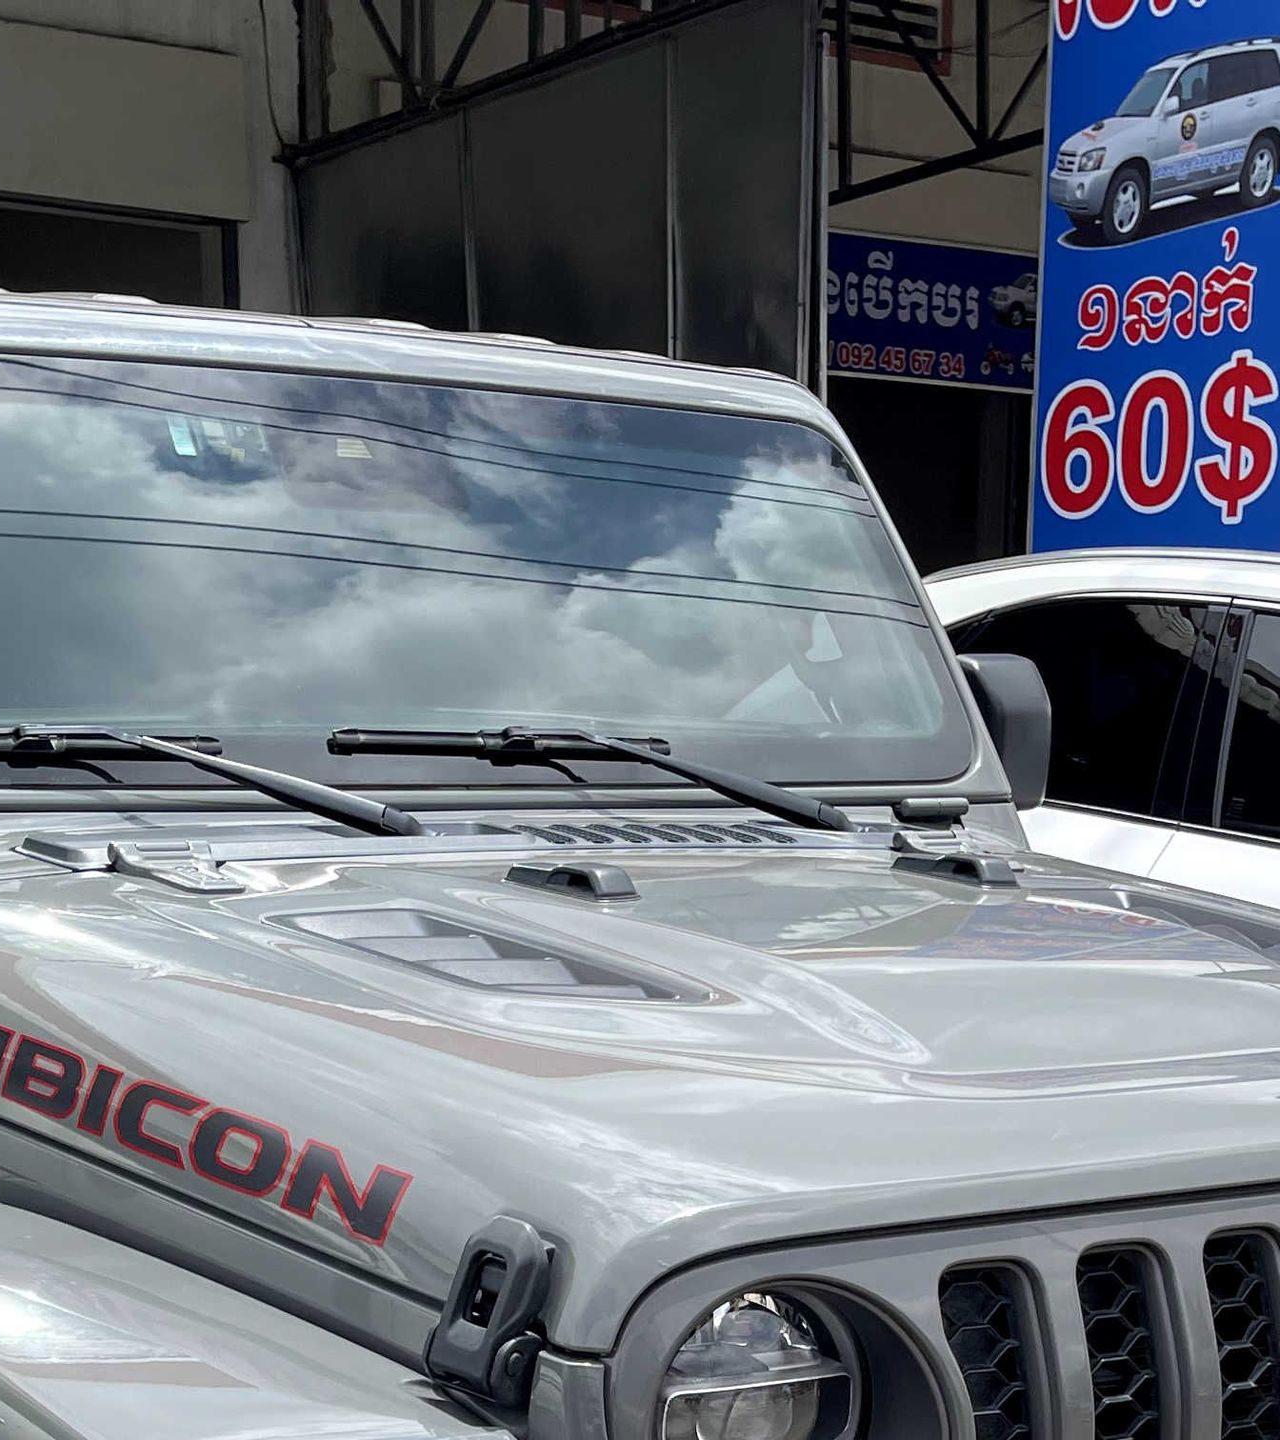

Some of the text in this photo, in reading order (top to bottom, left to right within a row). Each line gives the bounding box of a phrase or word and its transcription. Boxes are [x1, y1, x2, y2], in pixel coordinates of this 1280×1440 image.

[1077, 227, 1257, 351] ១នាក់
[837, 342, 876, 370] 092
[879, 346, 906, 372] 45
[910, 349, 935, 375] 67
[939, 352, 965, 378] 34
[1041, 349, 1279, 524] 60$
